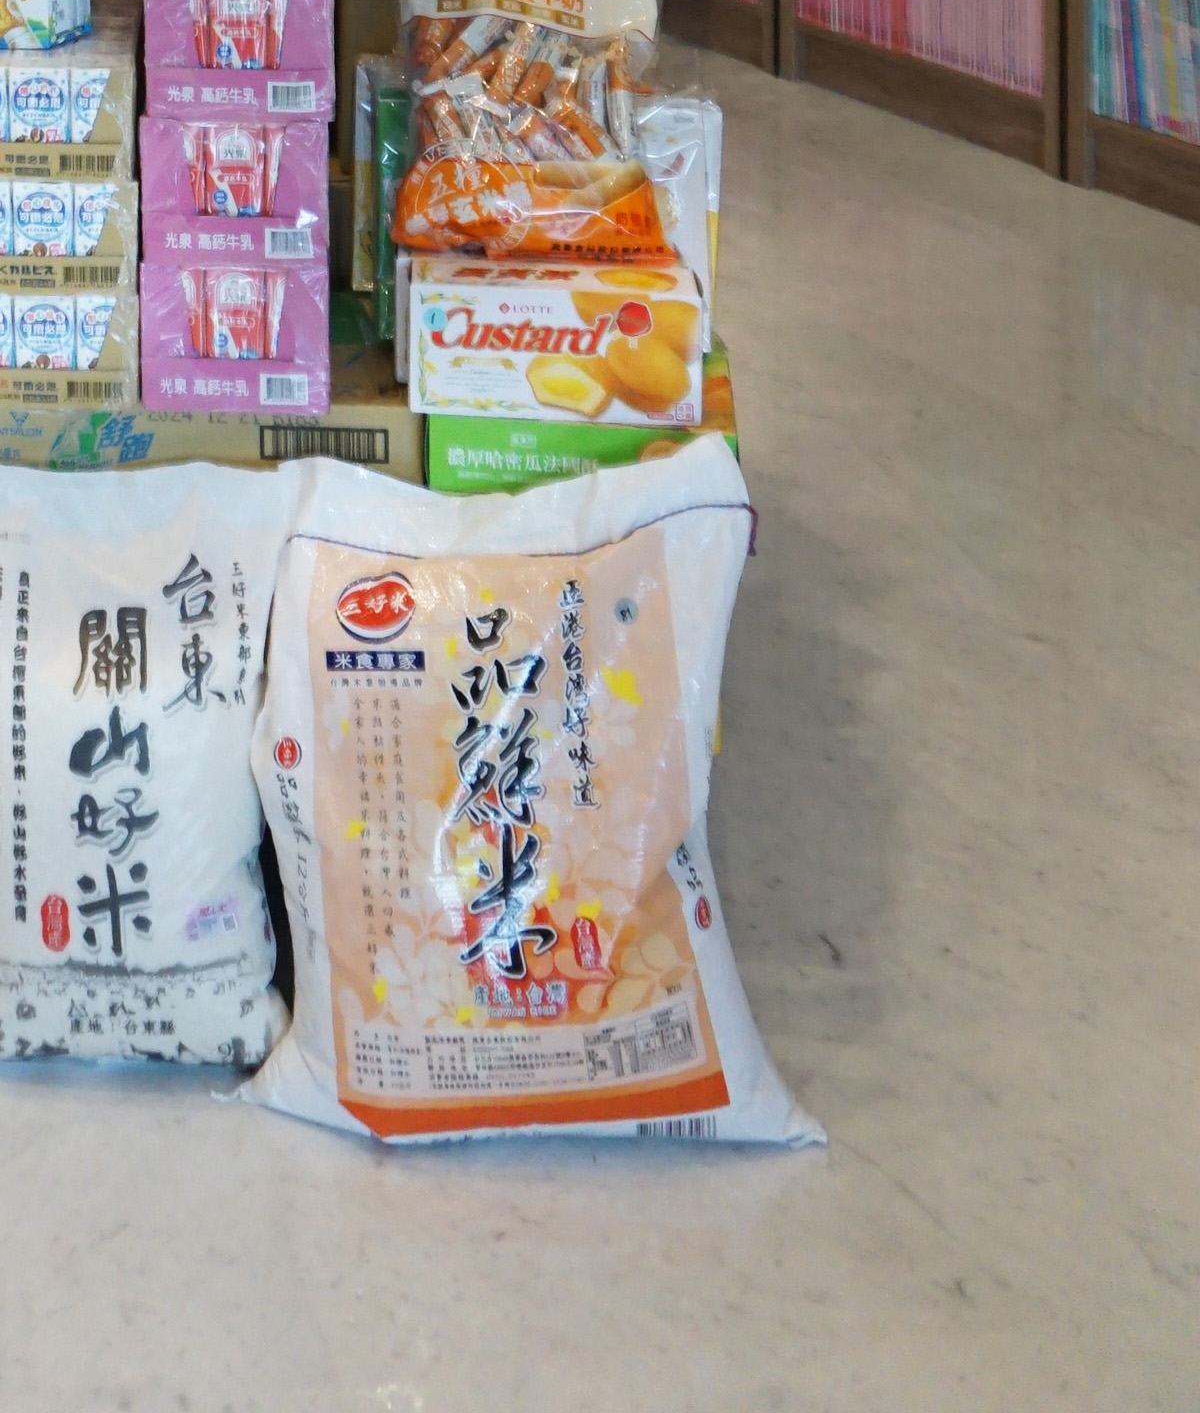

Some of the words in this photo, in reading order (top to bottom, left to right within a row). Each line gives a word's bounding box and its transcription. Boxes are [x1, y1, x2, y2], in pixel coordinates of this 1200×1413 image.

[166, 85, 195, 104] 光泉
[200, 87, 258, 107] 高鈣牛乳
[165, 231, 193, 249] 光泉
[197, 233, 255, 253] 高鈣牛乳
[511, 302, 555, 316] LOTTE
[429, 305, 613, 356] Custard
[159, 377, 189, 396] 光泉
[192, 378, 250, 398] 高鈣牛乳
[100, 413, 155, 463] 舒跑
[340, 588, 414, 619] 三好米
[161, 552, 229, 713] 台東
[333, 651, 420, 671] 米食專家
[558, 577, 602, 811] 正港台灣好味道
[68, 606, 160, 958] 關山好米
[449, 606, 560, 981] 品鮮米
